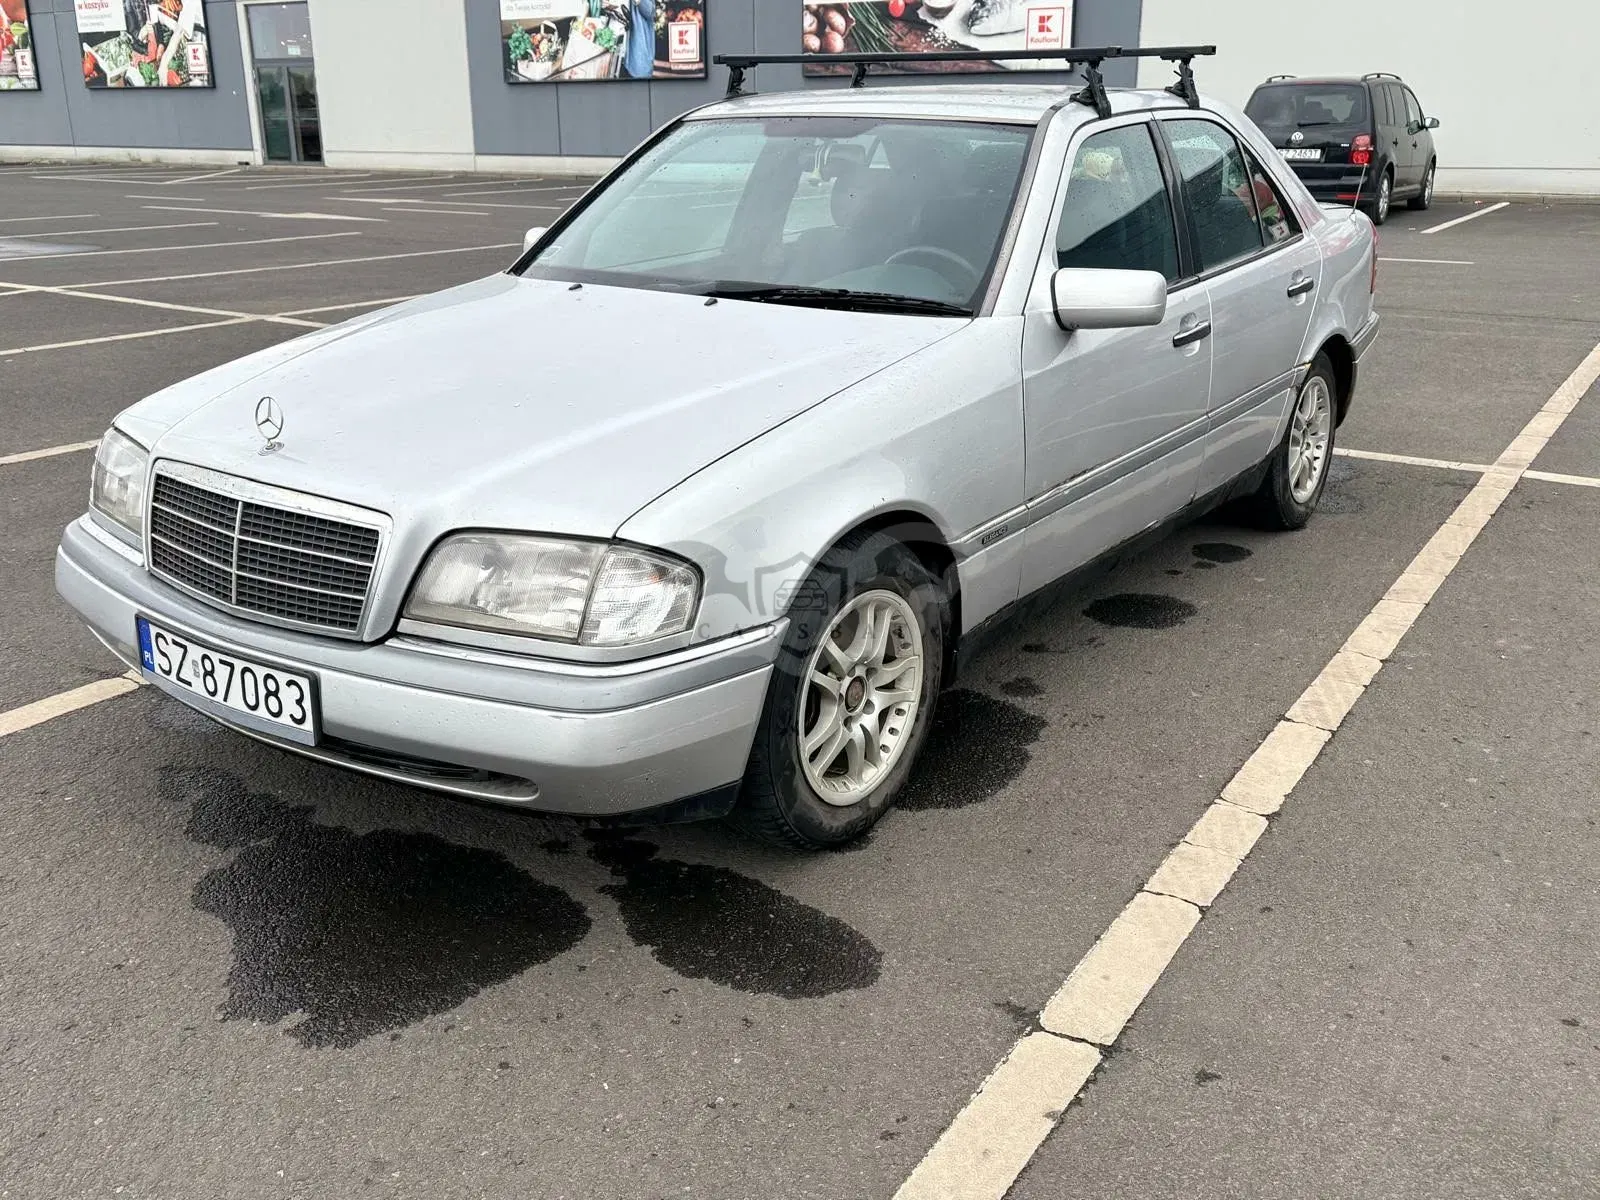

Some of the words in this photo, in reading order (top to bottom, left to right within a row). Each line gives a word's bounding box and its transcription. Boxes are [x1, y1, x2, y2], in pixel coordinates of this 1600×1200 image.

[143, 650, 154, 665] PL
[155, 631, 193, 688] SZ
[200, 653, 307, 725] 87083
